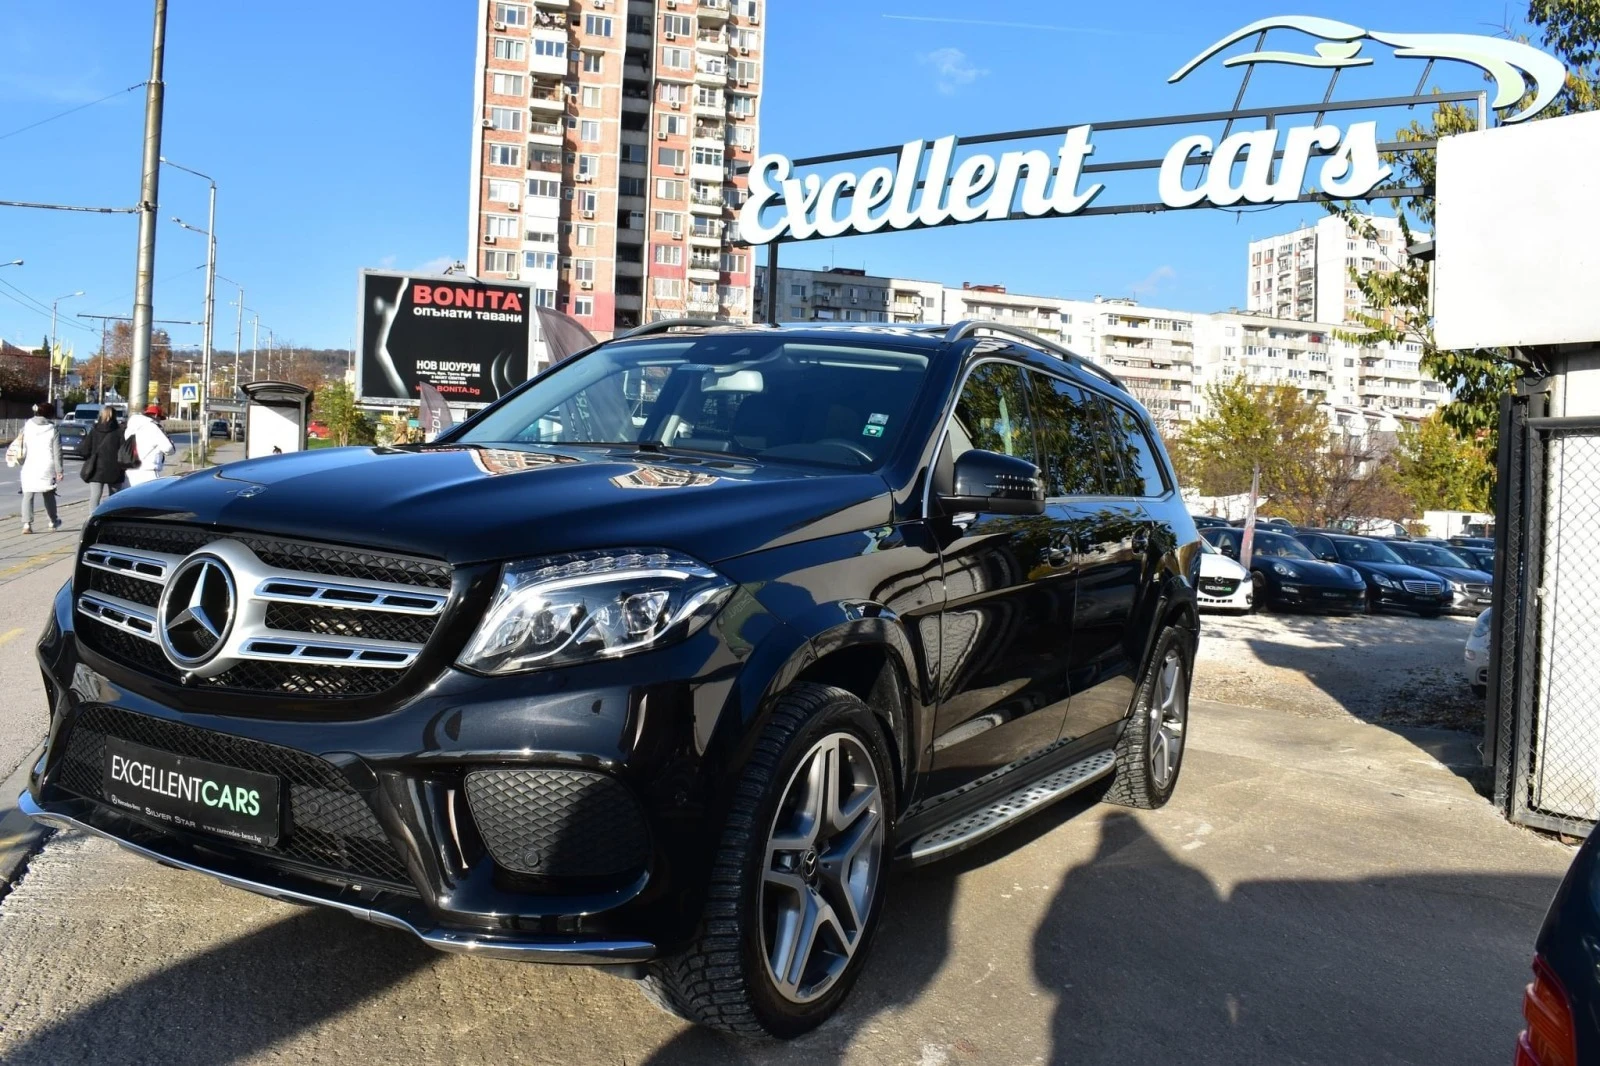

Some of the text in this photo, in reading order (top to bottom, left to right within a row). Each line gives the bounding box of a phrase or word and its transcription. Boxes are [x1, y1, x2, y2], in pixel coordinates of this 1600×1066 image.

[739, 121, 1392, 245] Excellent cars
[413, 285, 522, 311] BONITA
[413, 307, 523, 323] опънати тавани
[416, 360, 481, 373] НОВ ШОУРУМ
[145, 807, 172, 822] SILVER
[174, 815, 196, 828] STAR
